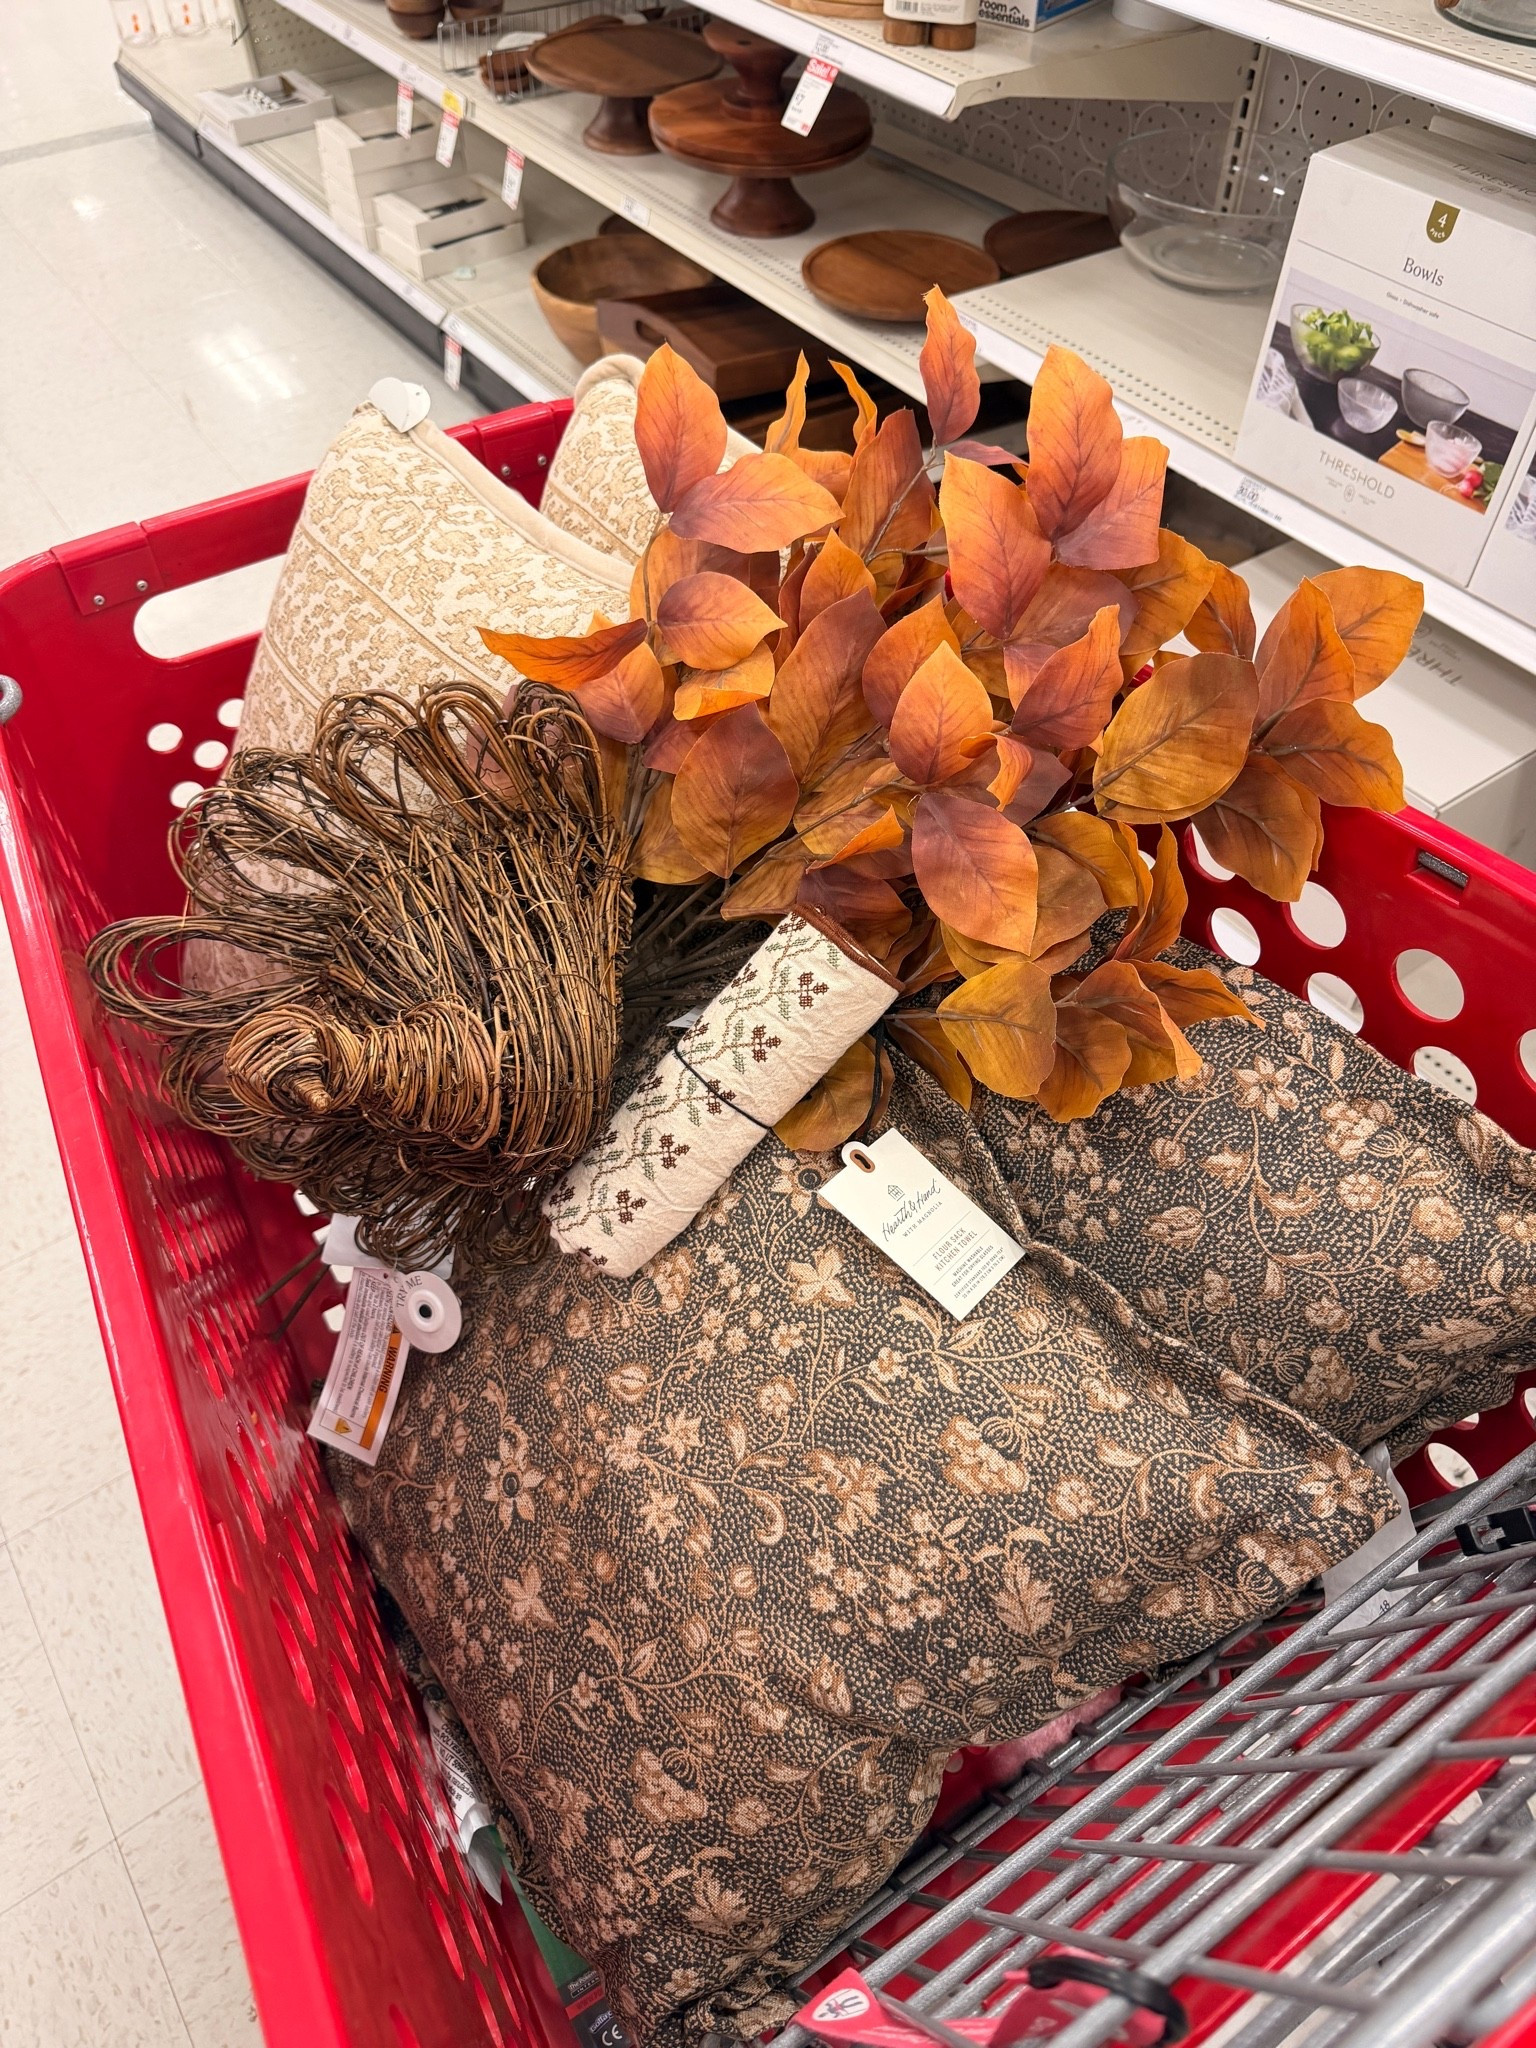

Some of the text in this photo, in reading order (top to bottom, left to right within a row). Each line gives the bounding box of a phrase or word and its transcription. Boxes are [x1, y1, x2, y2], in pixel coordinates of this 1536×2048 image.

[978, 9, 1029, 27] essentials
[980, 0, 1007, 12] room
[1429, 227, 1446, 238] PIECE
[1438, 213, 1448, 228] 4
[1402, 257, 1444, 287] Bowls
[1319, 450, 1395, 499] THRESHOLD
[882, 1178, 941, 1241] Hearth & Hand
[903, 1201, 942, 1237] WITH MAGNOLIA
[932, 1228, 966, 1260] FLOUR SACK
[934, 1231, 977, 1272] KITCHEN TOWEL
[951, 1276, 963, 1287] GREAT
[961, 1268, 969, 1277] FOR
[978, 1245, 993, 1259] GLASSES
[952, 1246, 983, 1277] MACHINE WASHABLE
[396, 1275, 422, 1307] TRY ME
[379, 1346, 399, 1393] WARNING
